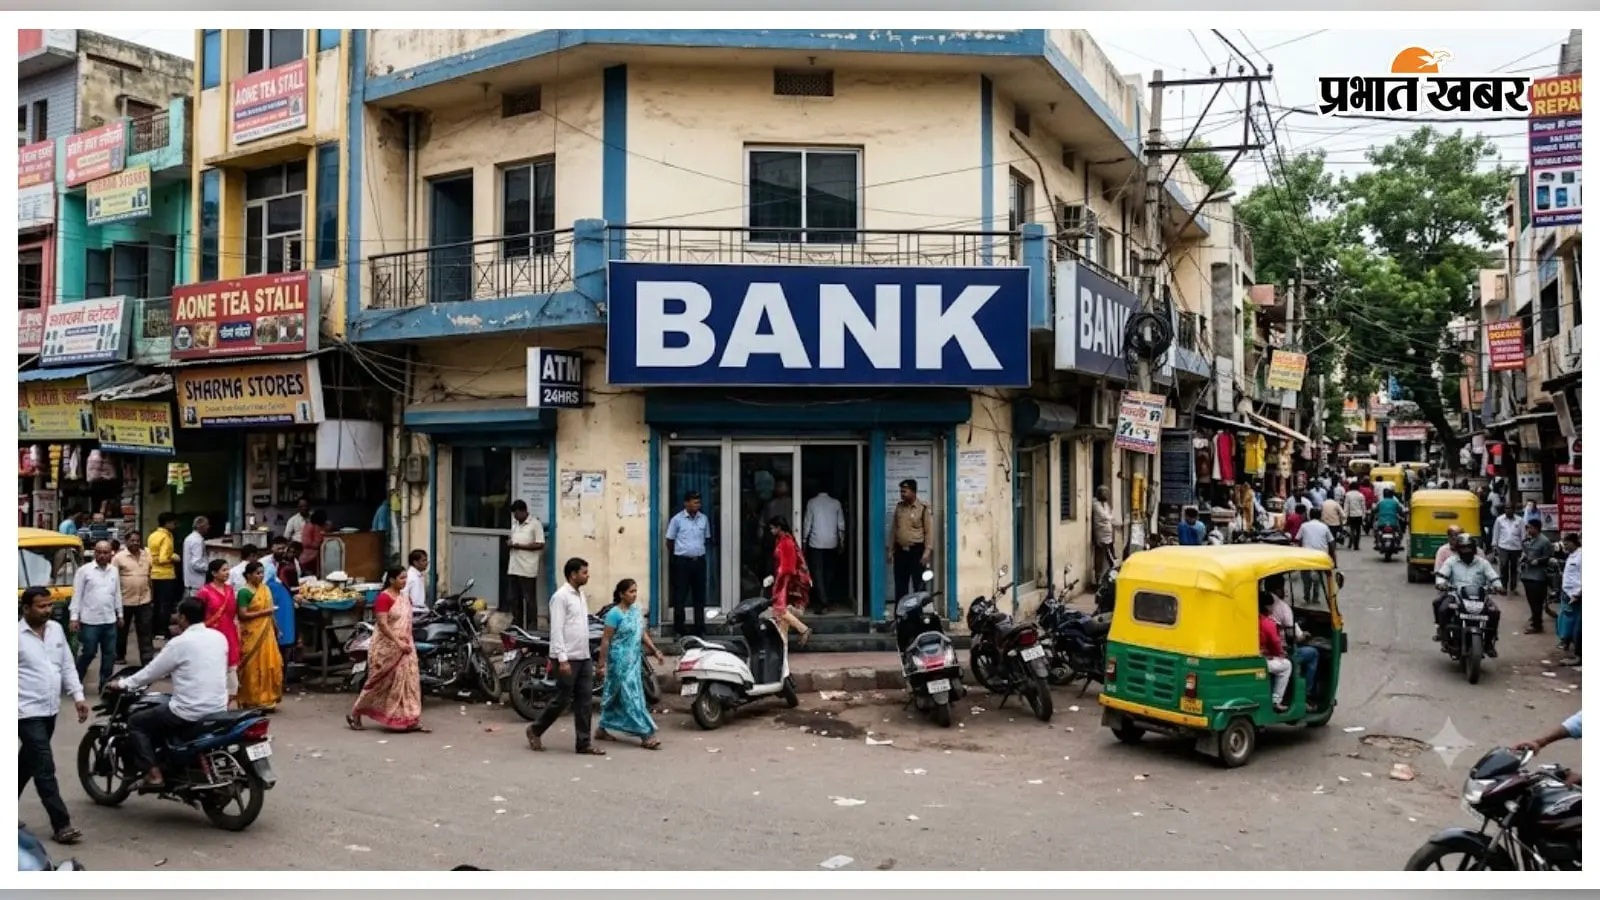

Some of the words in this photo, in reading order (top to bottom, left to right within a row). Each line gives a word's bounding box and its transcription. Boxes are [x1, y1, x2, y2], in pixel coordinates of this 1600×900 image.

[260, 79, 277, 99] TEA
[278, 68, 305, 95] STALL
[176, 293, 216, 320] AONE
[221, 290, 250, 316] TEA
[255, 284, 304, 313] STALL
[636, 281, 1003, 370] BANK
[542, 354, 581, 382] ATM
[185, 377, 243, 401] SHARMA
[248, 374, 304, 397] STORES
[544, 389, 579, 404] 24HRS
